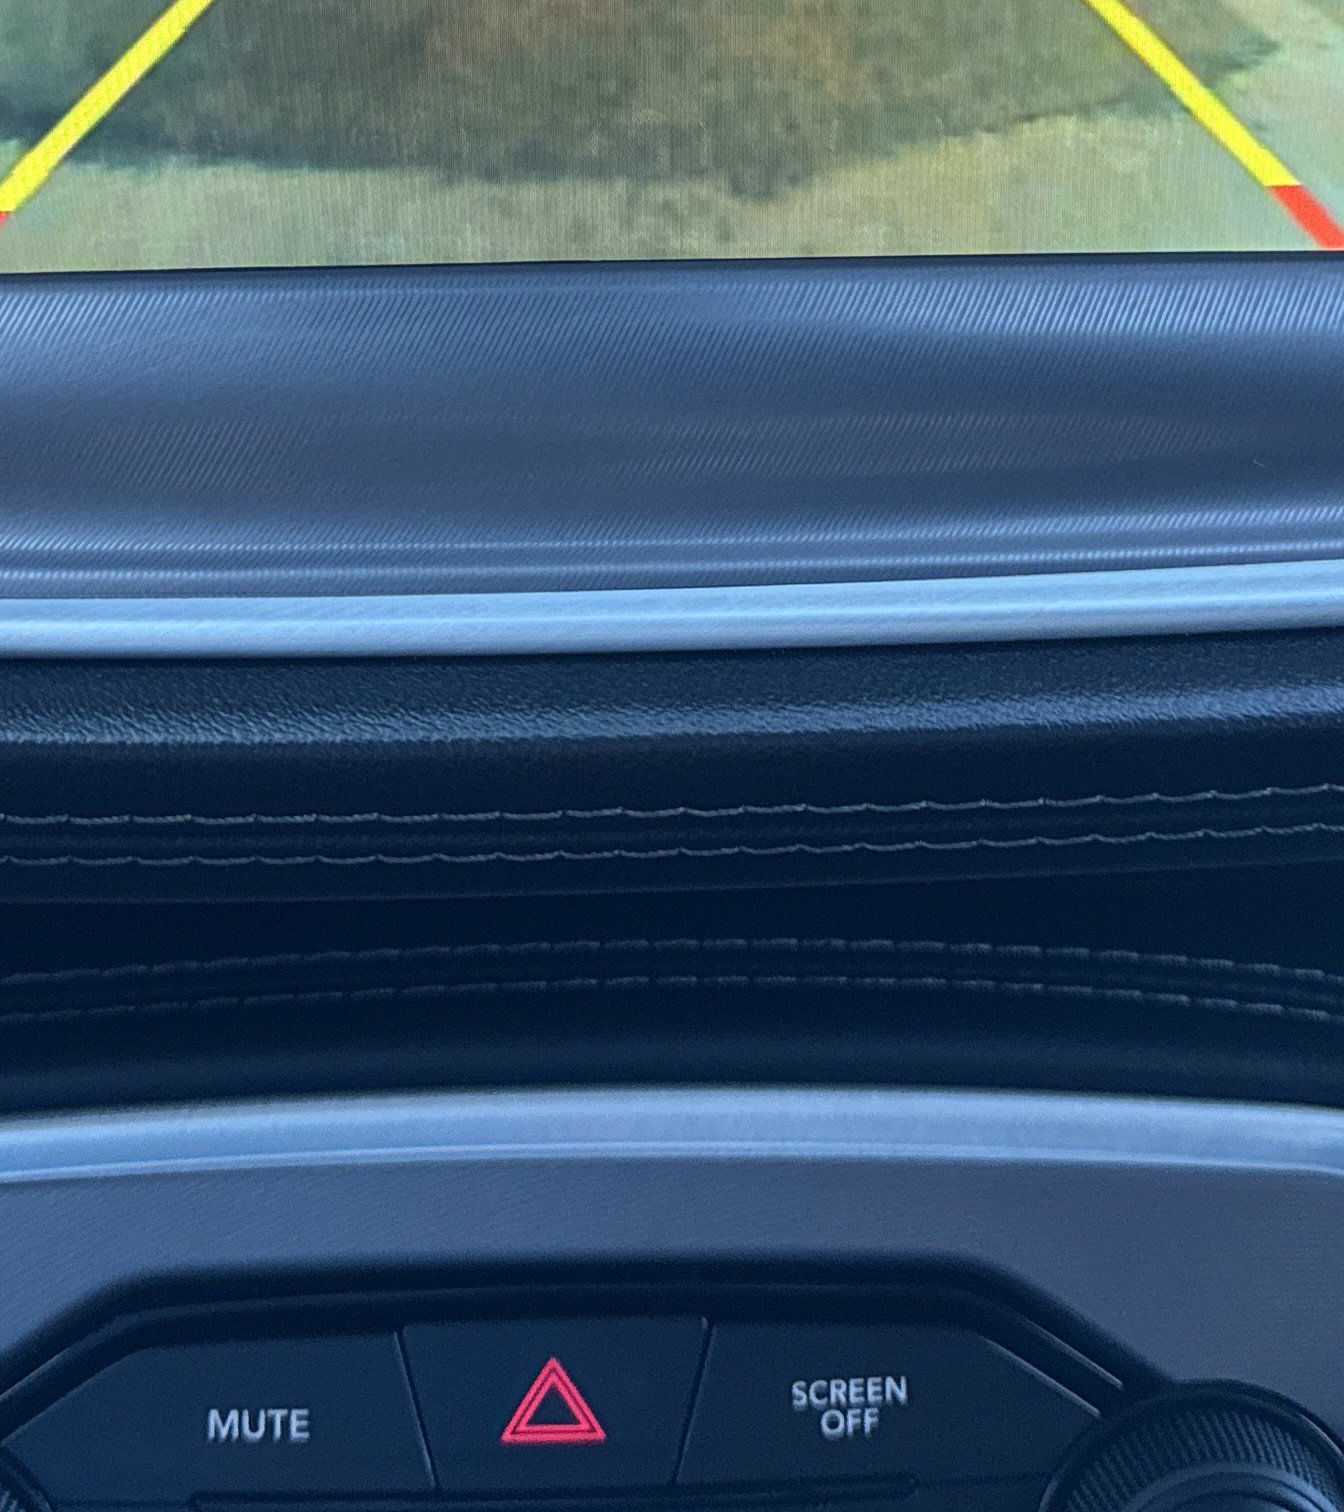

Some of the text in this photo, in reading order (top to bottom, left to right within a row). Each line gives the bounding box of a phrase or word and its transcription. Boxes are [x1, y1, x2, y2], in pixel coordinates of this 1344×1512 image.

[791, 1375, 908, 1409] SCREEN
[207, 1407, 311, 1442] MUTE
[820, 1407, 880, 1438] OFF
